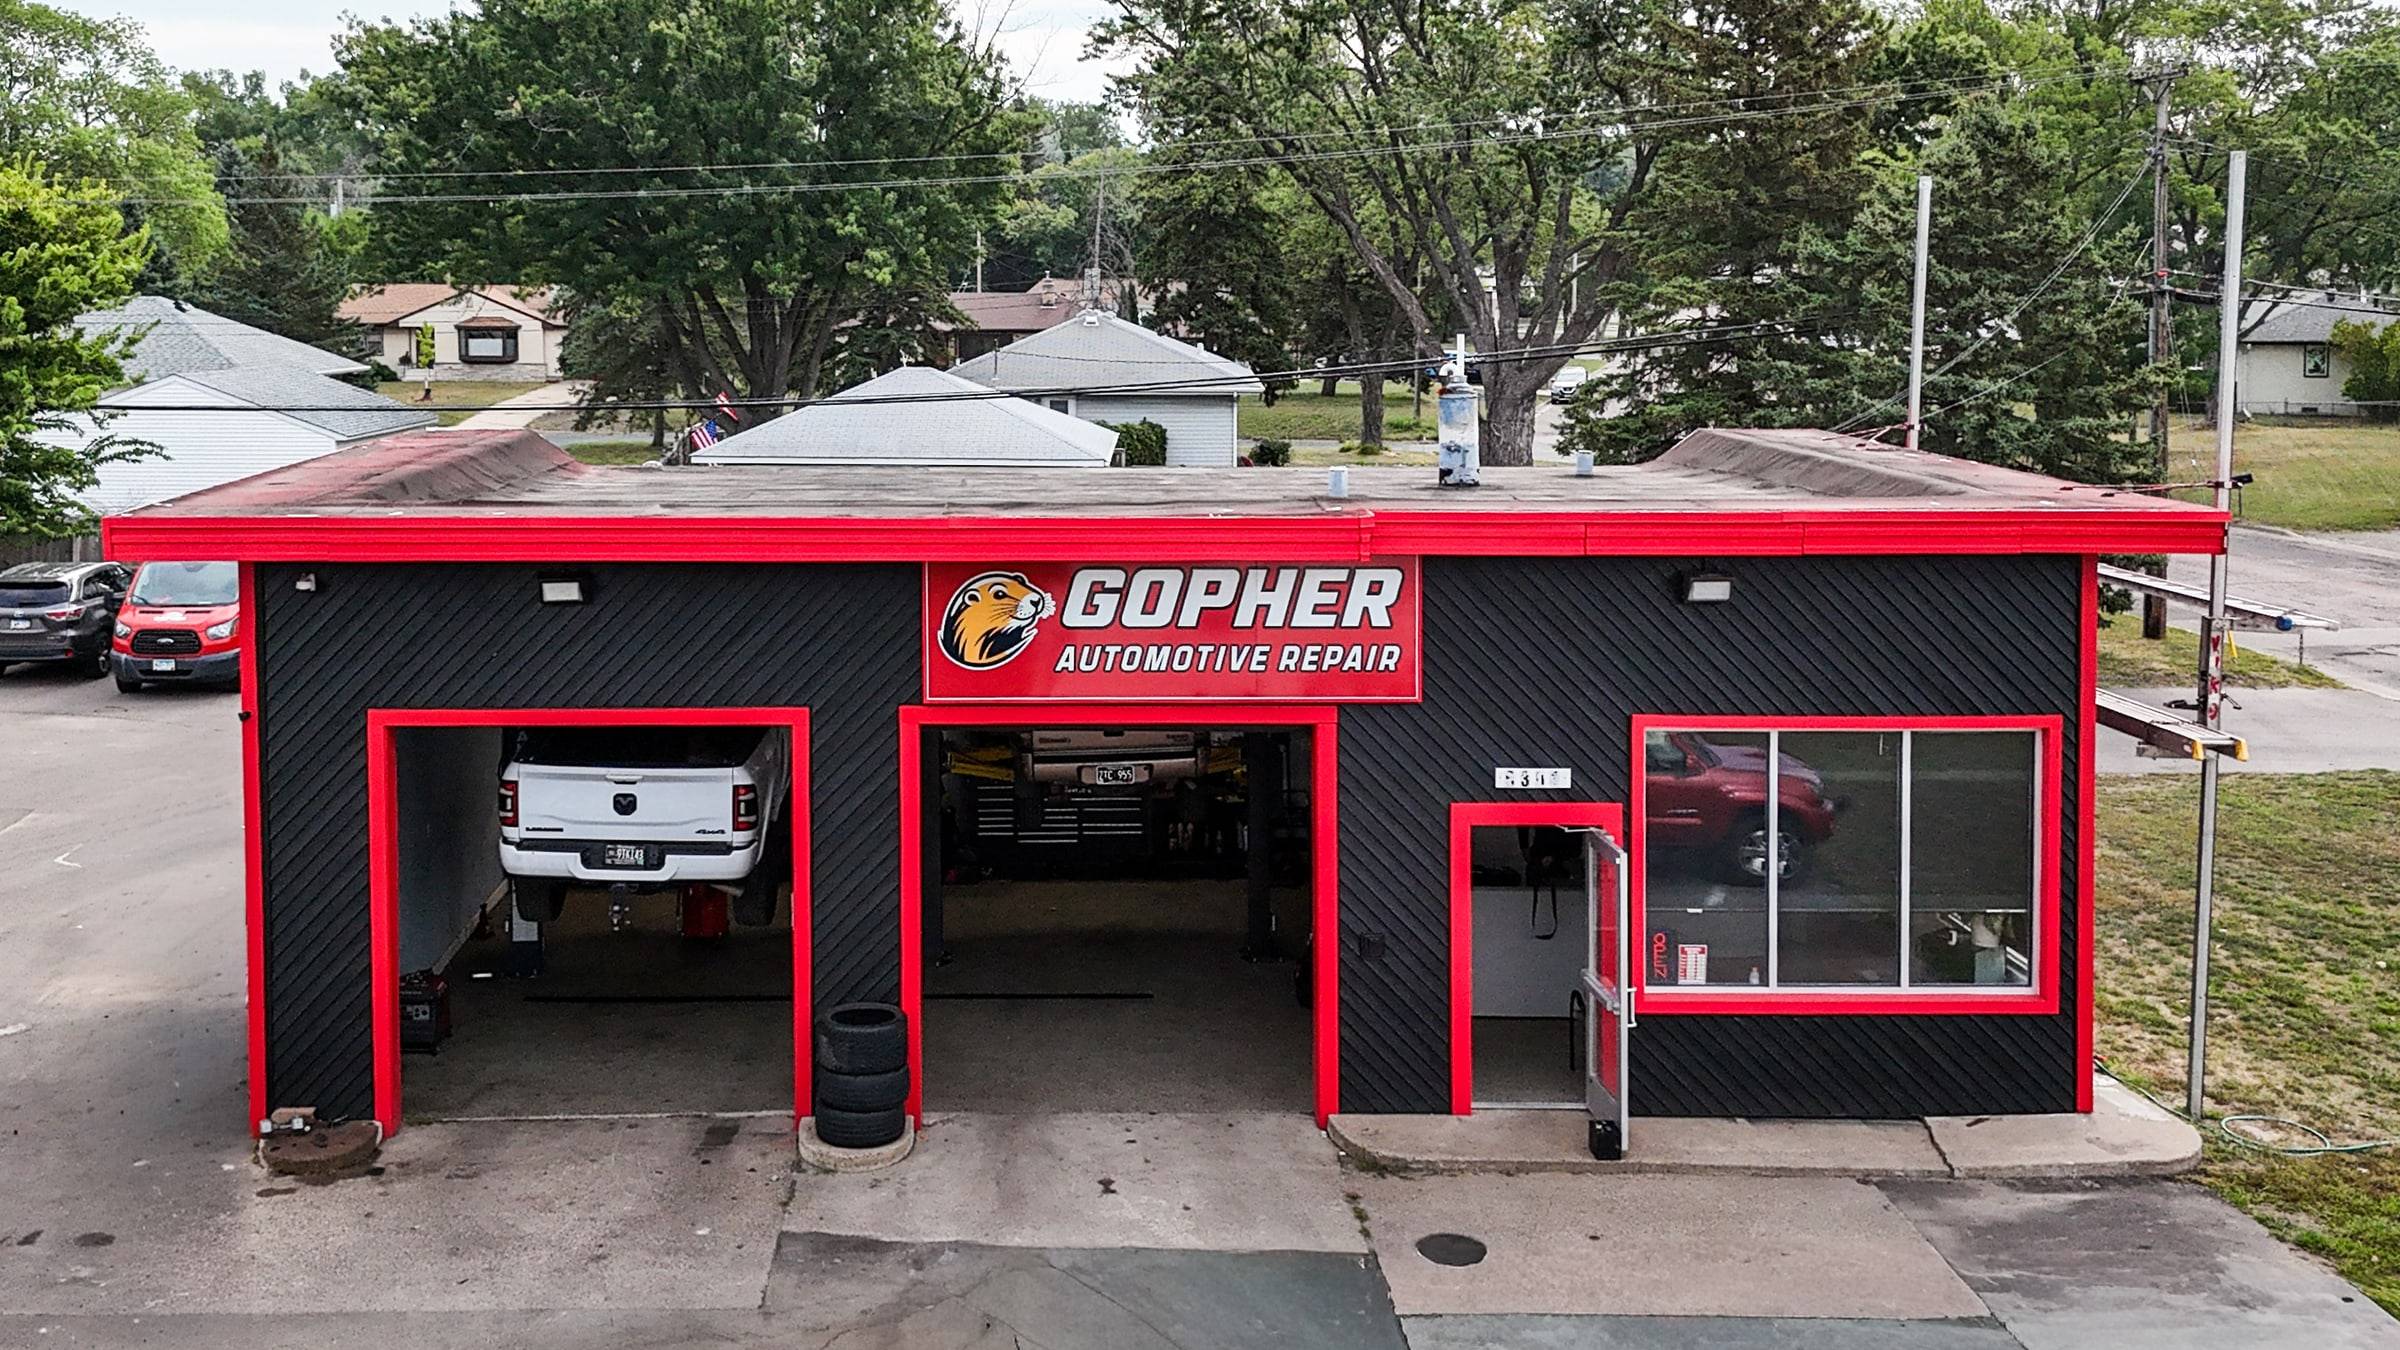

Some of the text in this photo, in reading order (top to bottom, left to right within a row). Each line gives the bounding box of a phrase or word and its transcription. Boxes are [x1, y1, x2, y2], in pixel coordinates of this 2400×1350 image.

[1061, 567, 1404, 628] GOPHER
[1055, 644, 1401, 673] AUTOMOTIVE REPAIR
